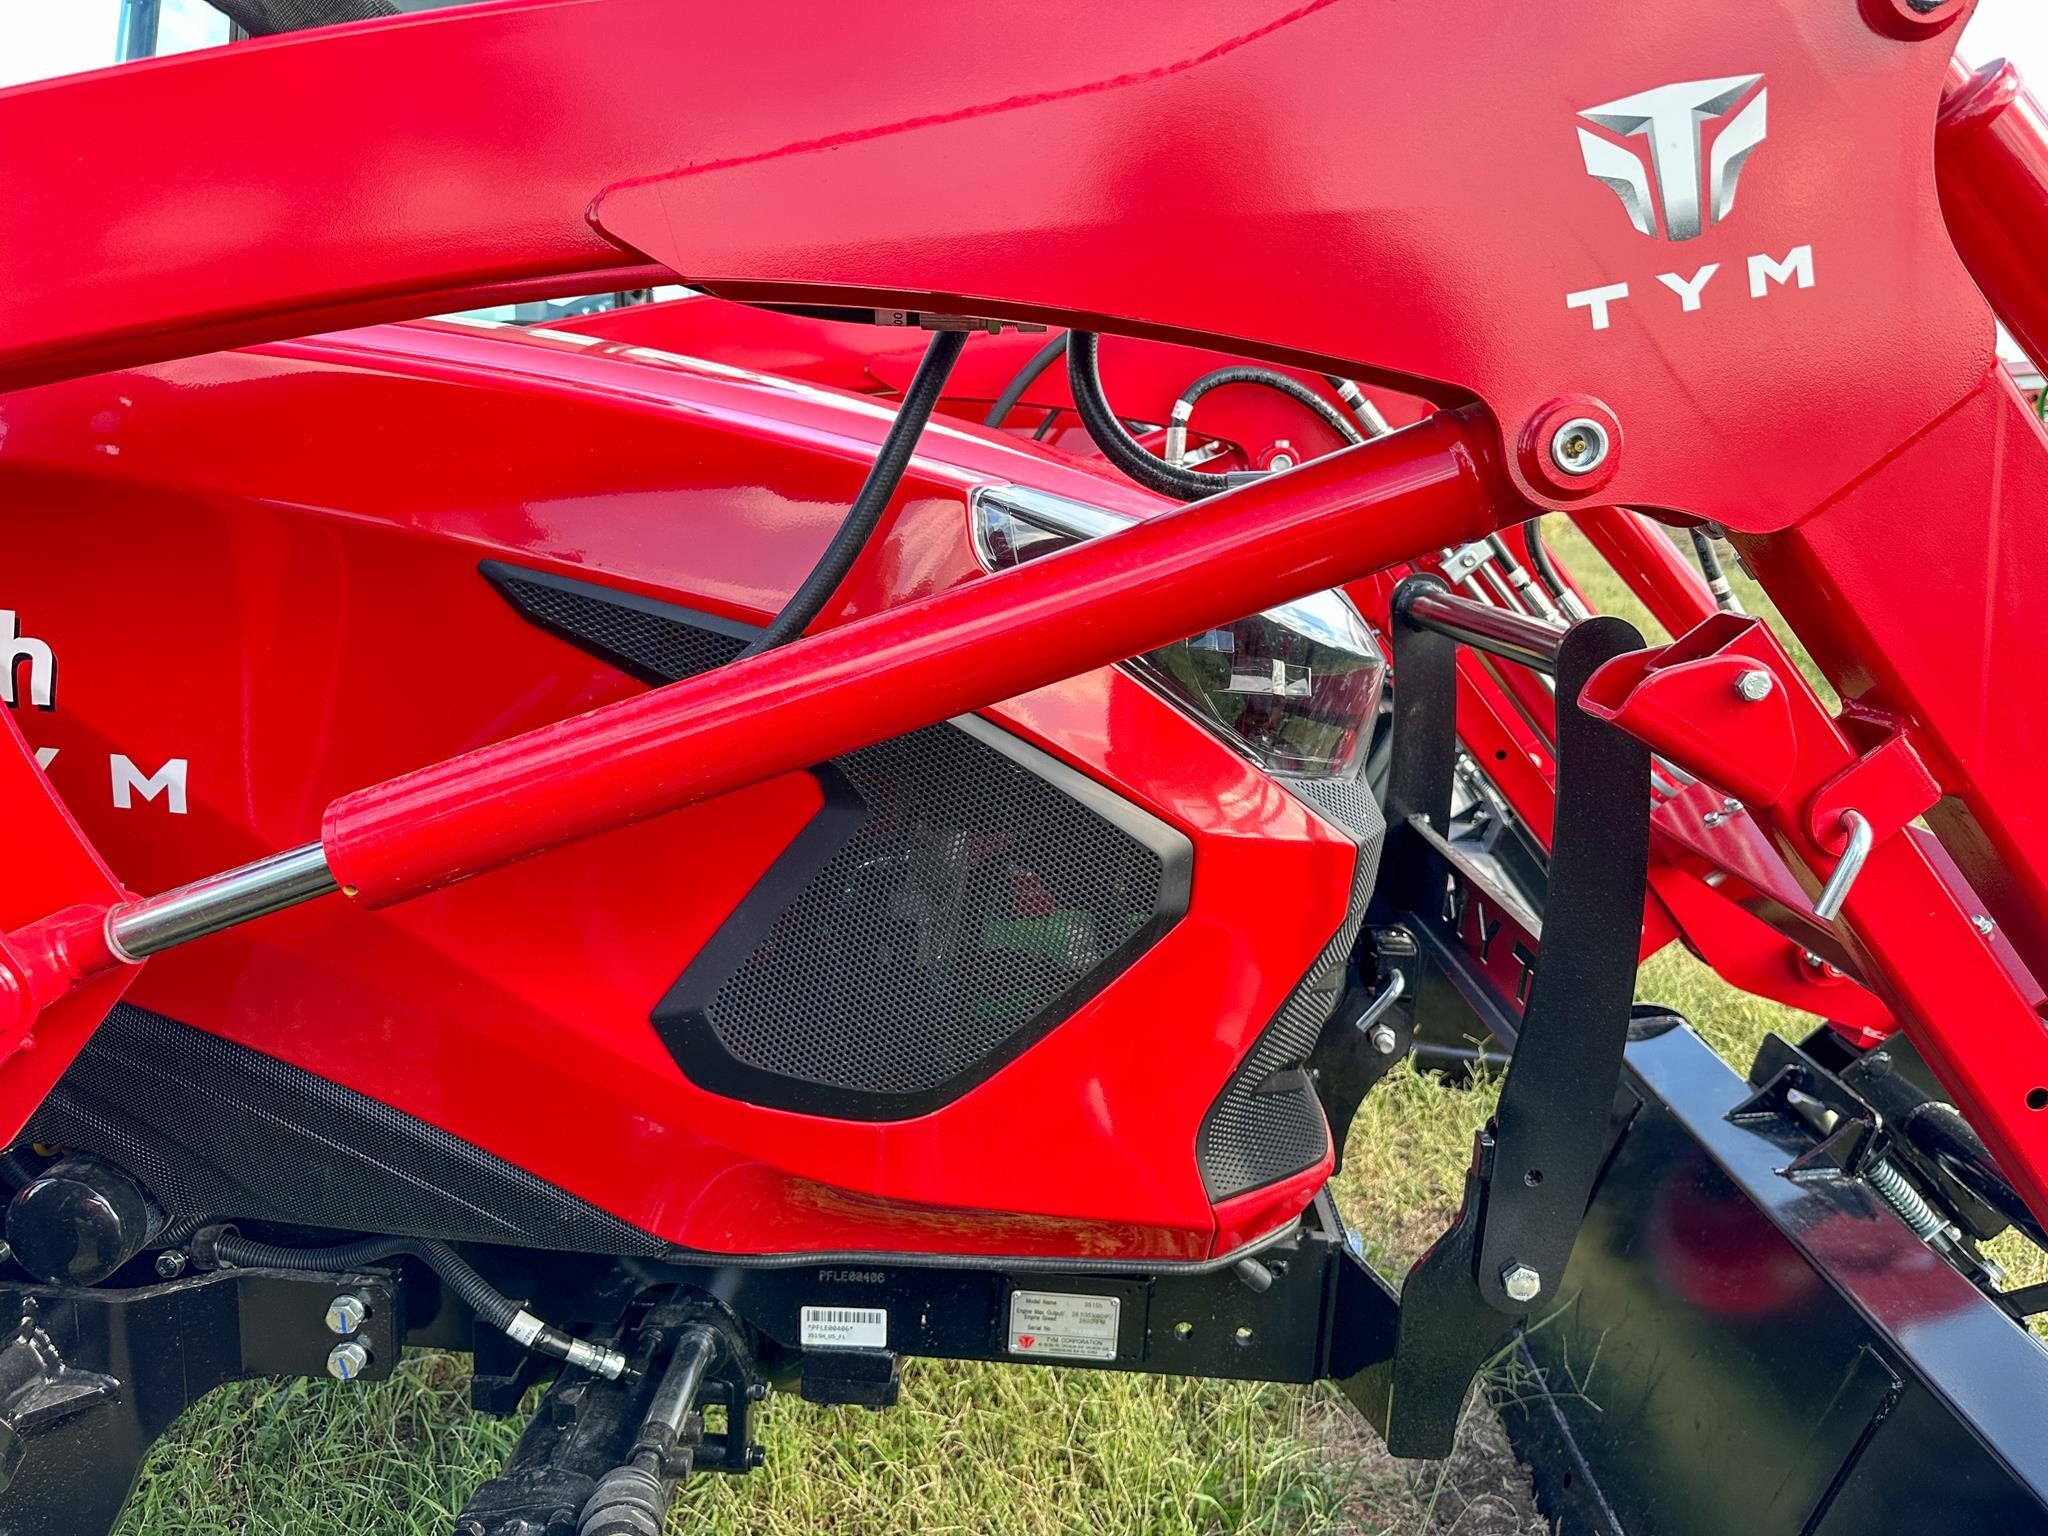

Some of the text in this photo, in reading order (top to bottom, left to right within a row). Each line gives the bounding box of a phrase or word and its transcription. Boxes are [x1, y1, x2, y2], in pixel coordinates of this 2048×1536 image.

[1566, 244, 1815, 330] TYM
[33, 747, 188, 815] M
[819, 1269, 886, 1284] PFLE00406
